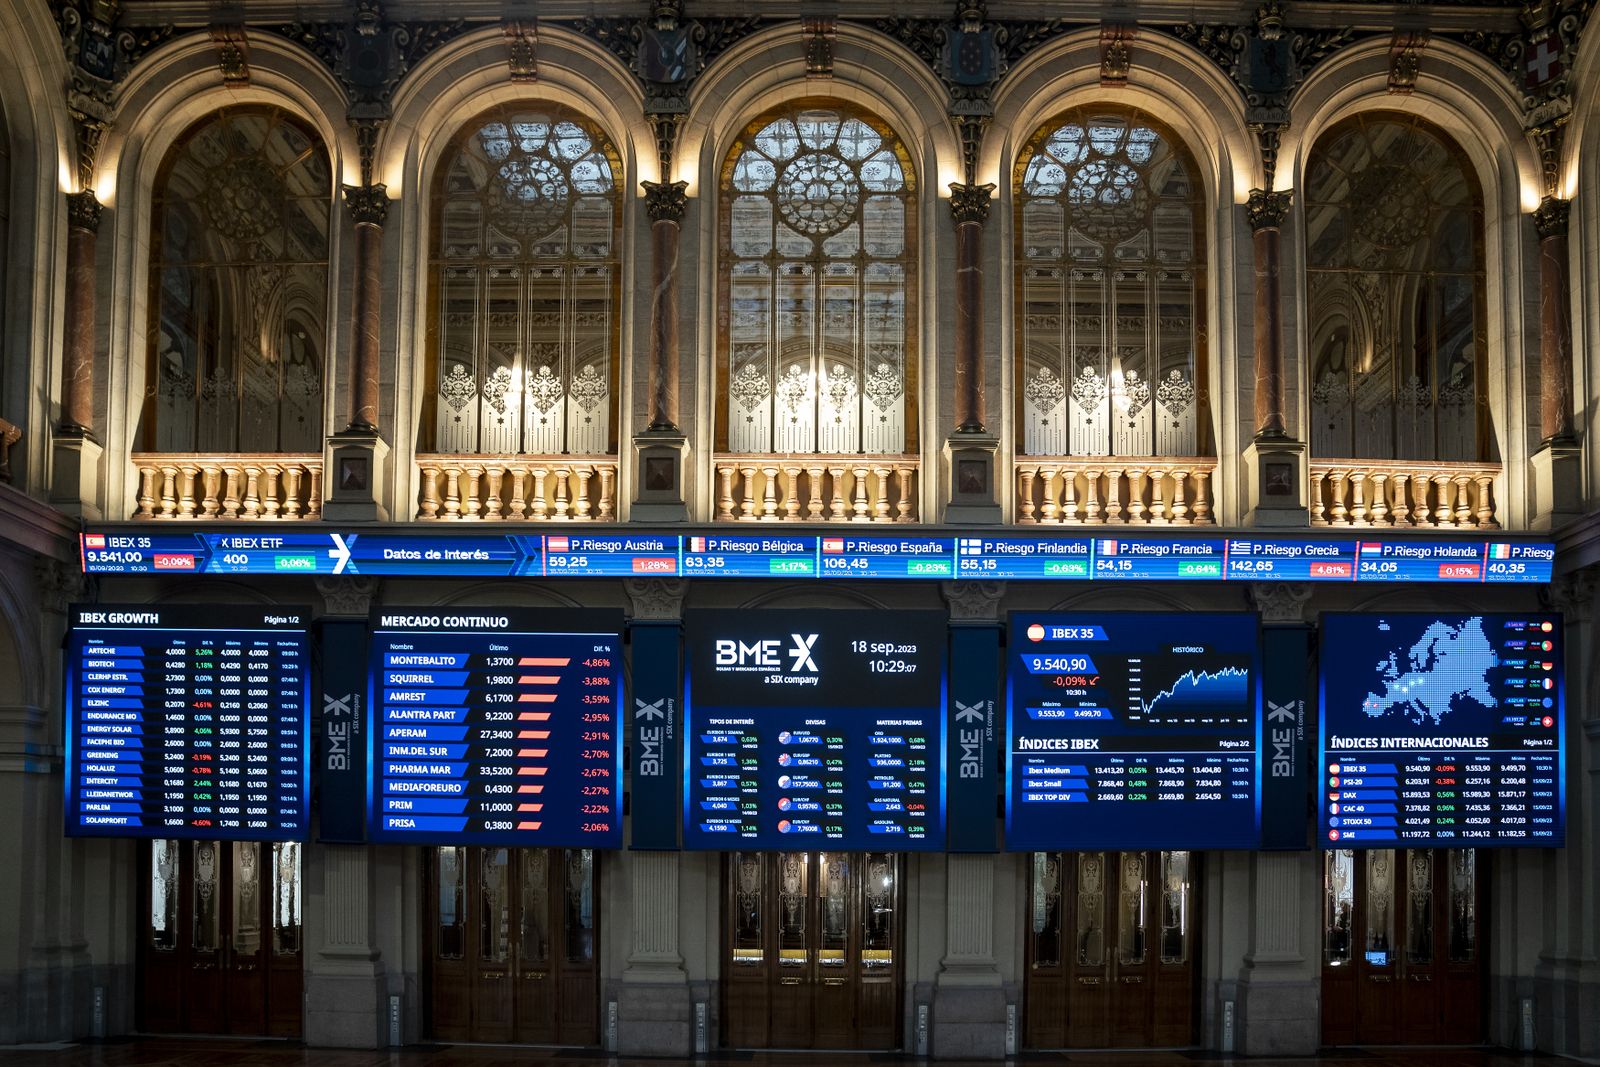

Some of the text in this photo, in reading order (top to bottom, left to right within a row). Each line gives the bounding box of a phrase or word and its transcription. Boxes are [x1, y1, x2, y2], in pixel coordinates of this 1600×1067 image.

[1252, 113, 1286, 121] HOLANDA
[109, 537, 151, 548] IBEX 35
[231, 538, 258, 548] IBEX
[261, 538, 283, 548] ETF
[572, 540, 664, 553] P.Riesgo Austria
[709, 540, 804, 553] P.Riesgo Bélgica
[847, 541, 943, 555] P.Riesgo España
[984, 542, 1087, 555] P.Riesgo Finlandia
[384, 549, 489, 560] Datos de Interés
[1120, 543, 1212, 556] P.Riesgo Francia
[1253, 544, 1339, 557] P.Riesgo Grecia
[1384, 546, 1477, 559] P.Riesgo Holanda
[1512, 547, 1554, 560] P.Riesg
[87, 552, 191, 567] 9.541,00 -0,09%
[223, 554, 248, 564] 400
[549, 557, 671, 571] 59,25 1,28%
[685, 557, 808, 572] 63,35 -1,17%
[823, 558, 947, 573] 106,45 -0,23%
[961, 559, 1084, 573] 55,15 -0,63%
[1097, 560, 1217, 574] 54,15 -0,64%
[1230, 561, 1346, 576] 142,65 4,81%
[1360, 562, 1474, 577] 34,05 0,15%
[1489, 563, 1525, 575] 40,35
[80, 613, 158, 624] IBEX GROWTH
[264, 616, 287, 625] Página
[381, 616, 508, 627] MERCADO CONTINUO
[1052, 628, 1094, 638] IBEX 35
[716, 640, 781, 665] BME
[852, 641, 916, 656] 18 sep.2023
[390, 656, 610, 667] MONTEBALITO 1,3700 -4,86%
[869, 660, 916, 672] 10:29:07
[1033, 658, 1087, 672] 9.540,90
[390, 674, 610, 686] SQUIRREL 1,9800 -3,88%
[771, 675, 783, 683] SIX
[784, 676, 819, 686] company
[1053, 676, 1086, 686] -0,09%
[390, 692, 610, 704] AMREST 6,1700 -3,59%
[389, 710, 610, 722] ALANTRA PART 9,2200 -2,95%
[666, 698, 674, 724] company
[389, 729, 609, 741] APERAM 27,3400 -2,91%
[1331, 735, 1489, 748] ÍNDICES INTERNACIONALES
[328, 722, 346, 770] BME
[1019, 736, 1099, 749] ÍNDICES IBEX
[1219, 740, 1239, 748] Página
[1523, 739, 1542, 747] Página
[389, 746, 609, 759] INM.DEL SUR 7,2000 -2,70%
[640, 727, 659, 776] BME
[960, 729, 979, 778] BME
[1272, 728, 1290, 776] BME
[390, 765, 609, 777] PHARMA MAR 33,5200 -2,67%
[389, 783, 609, 795] MEDIAFOREURO 0,4300 -2,27%
[389, 801, 609, 814] PRIM 11,0000 -2,22%
[389, 819, 609, 832] PRISA 0,3800 -2,06%
